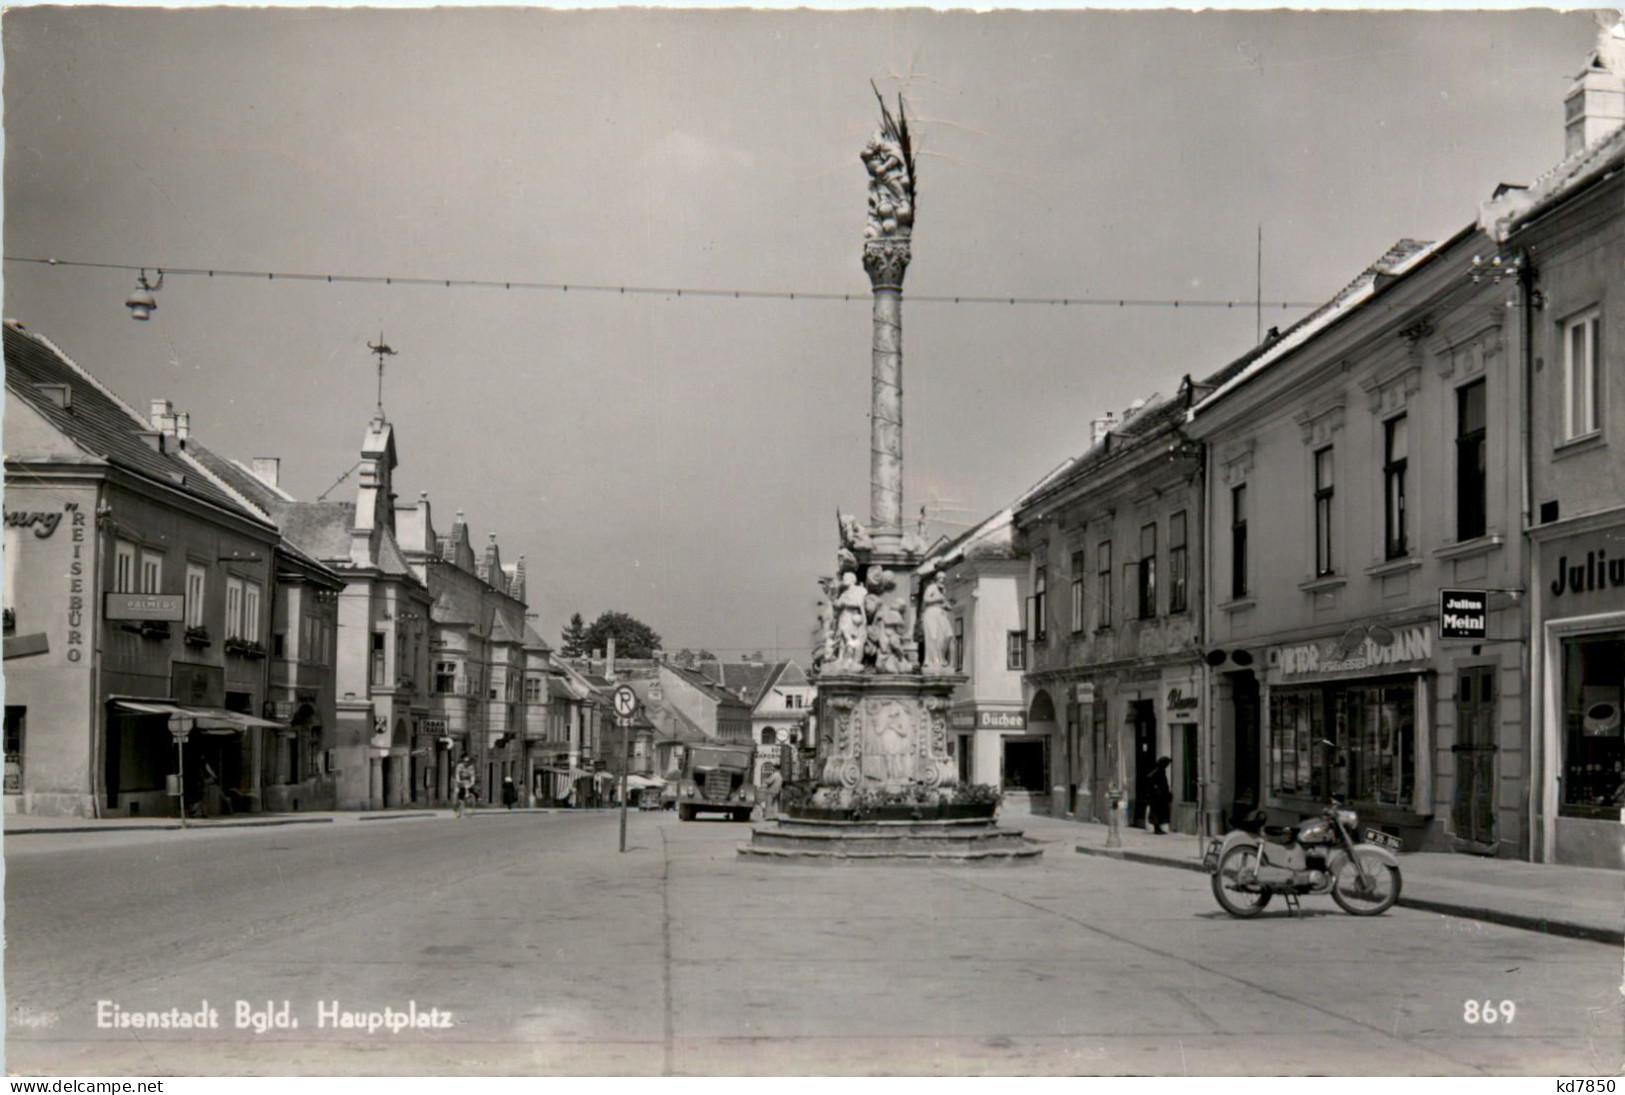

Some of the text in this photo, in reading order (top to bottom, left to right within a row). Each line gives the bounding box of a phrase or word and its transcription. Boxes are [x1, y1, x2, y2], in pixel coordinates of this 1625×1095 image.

[67, 512, 86, 663] REISEBÜRO
[127, 600, 177, 609] PALMERS
[1446, 598, 1482, 610] Julius
[1443, 614, 1485, 629] Meinl
[620, 691, 632, 711] R
